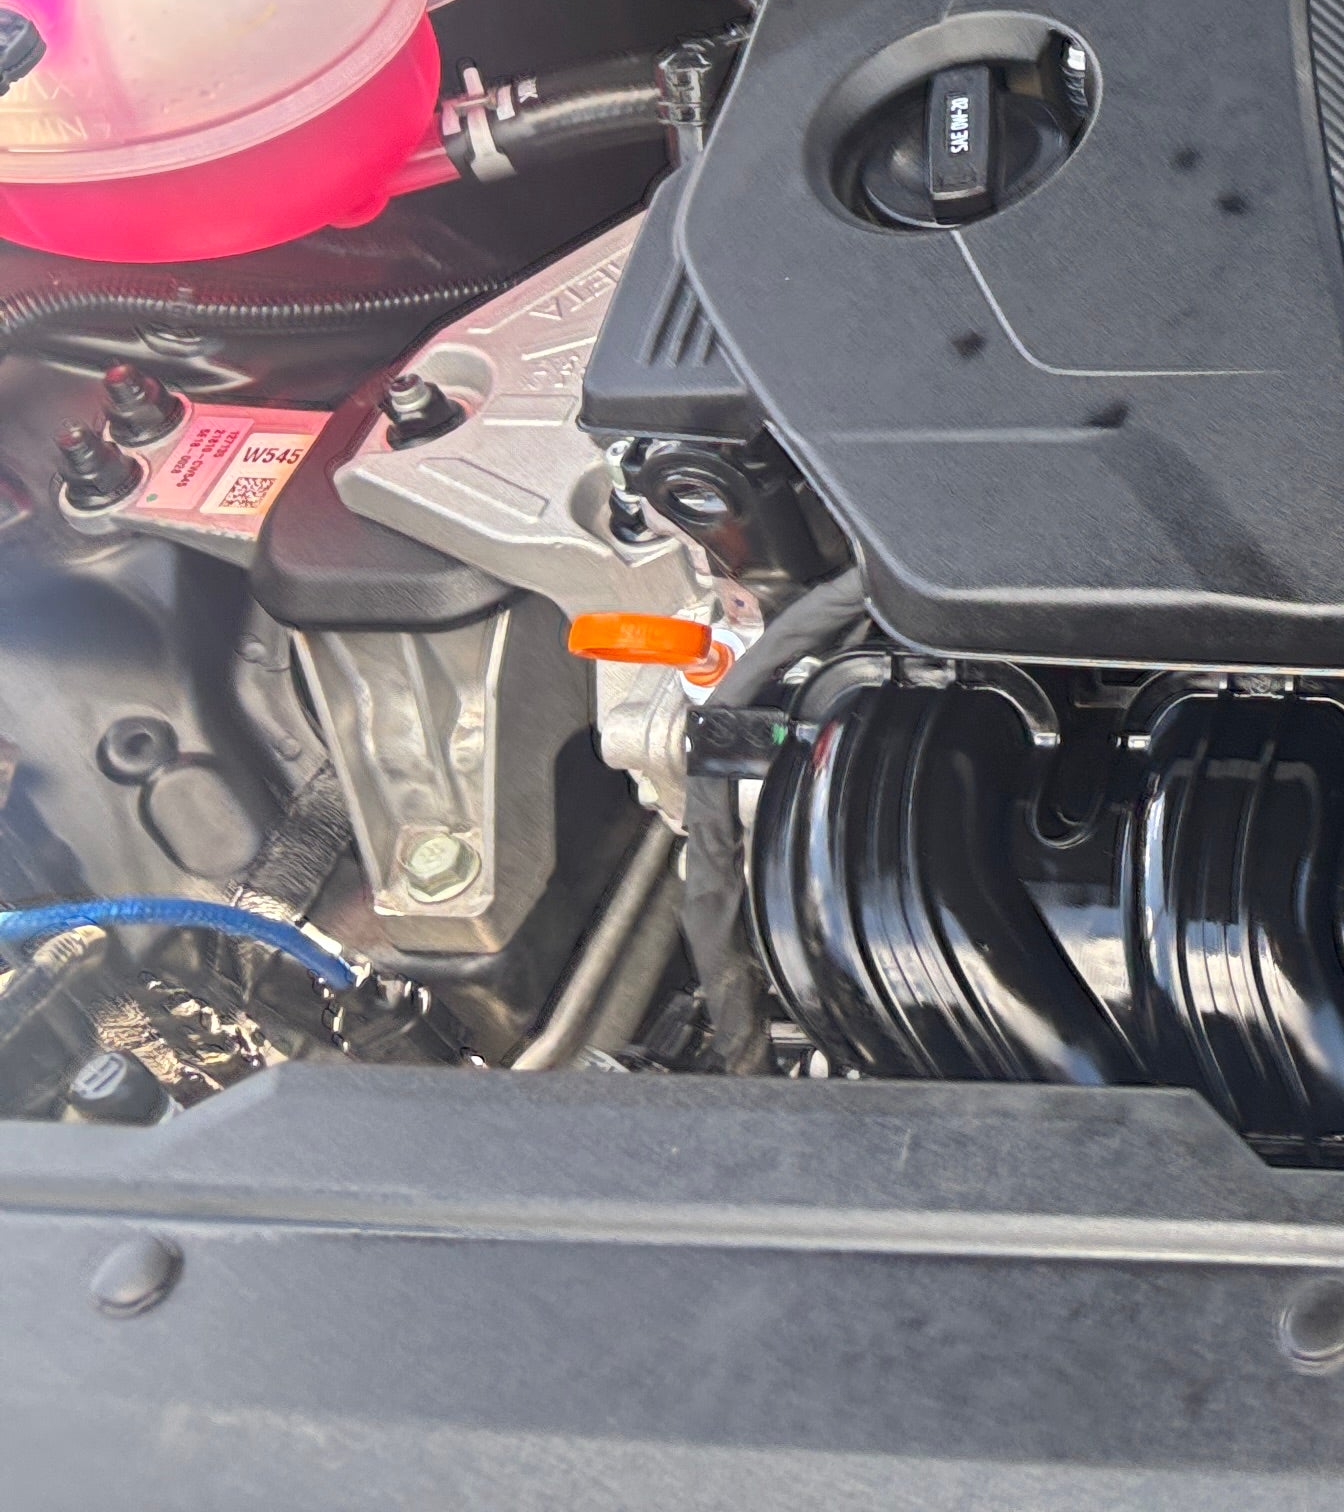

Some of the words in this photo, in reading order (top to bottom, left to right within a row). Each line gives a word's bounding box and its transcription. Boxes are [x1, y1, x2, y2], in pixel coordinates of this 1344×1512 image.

[950, 130, 969, 155] SAE
[529, 264, 621, 322] ETA
[243, 447, 304, 465] W545
